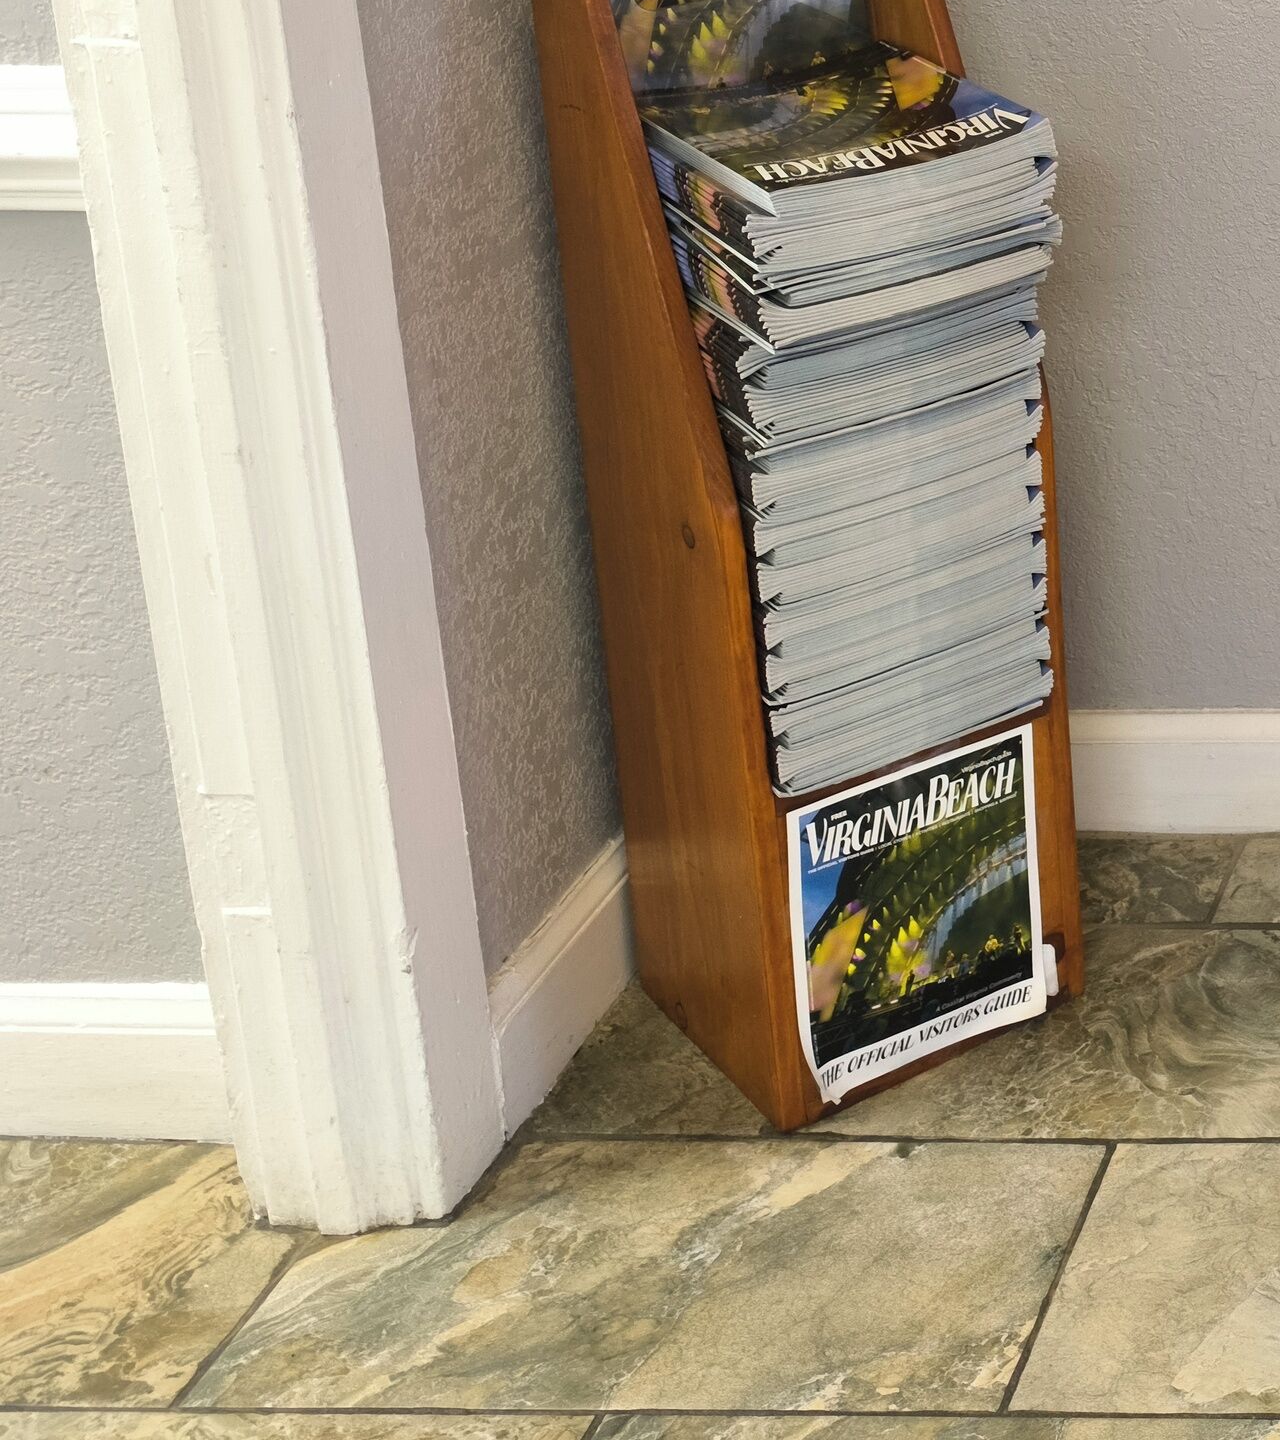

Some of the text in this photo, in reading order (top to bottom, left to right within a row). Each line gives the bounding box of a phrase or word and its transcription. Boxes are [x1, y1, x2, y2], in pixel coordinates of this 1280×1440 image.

[821, 1061, 844, 1091] THE
[847, 1034, 915, 1074] OFFICIAL
[919, 1004, 982, 1043] VISITORS
[983, 985, 1033, 1015] GUIDE
